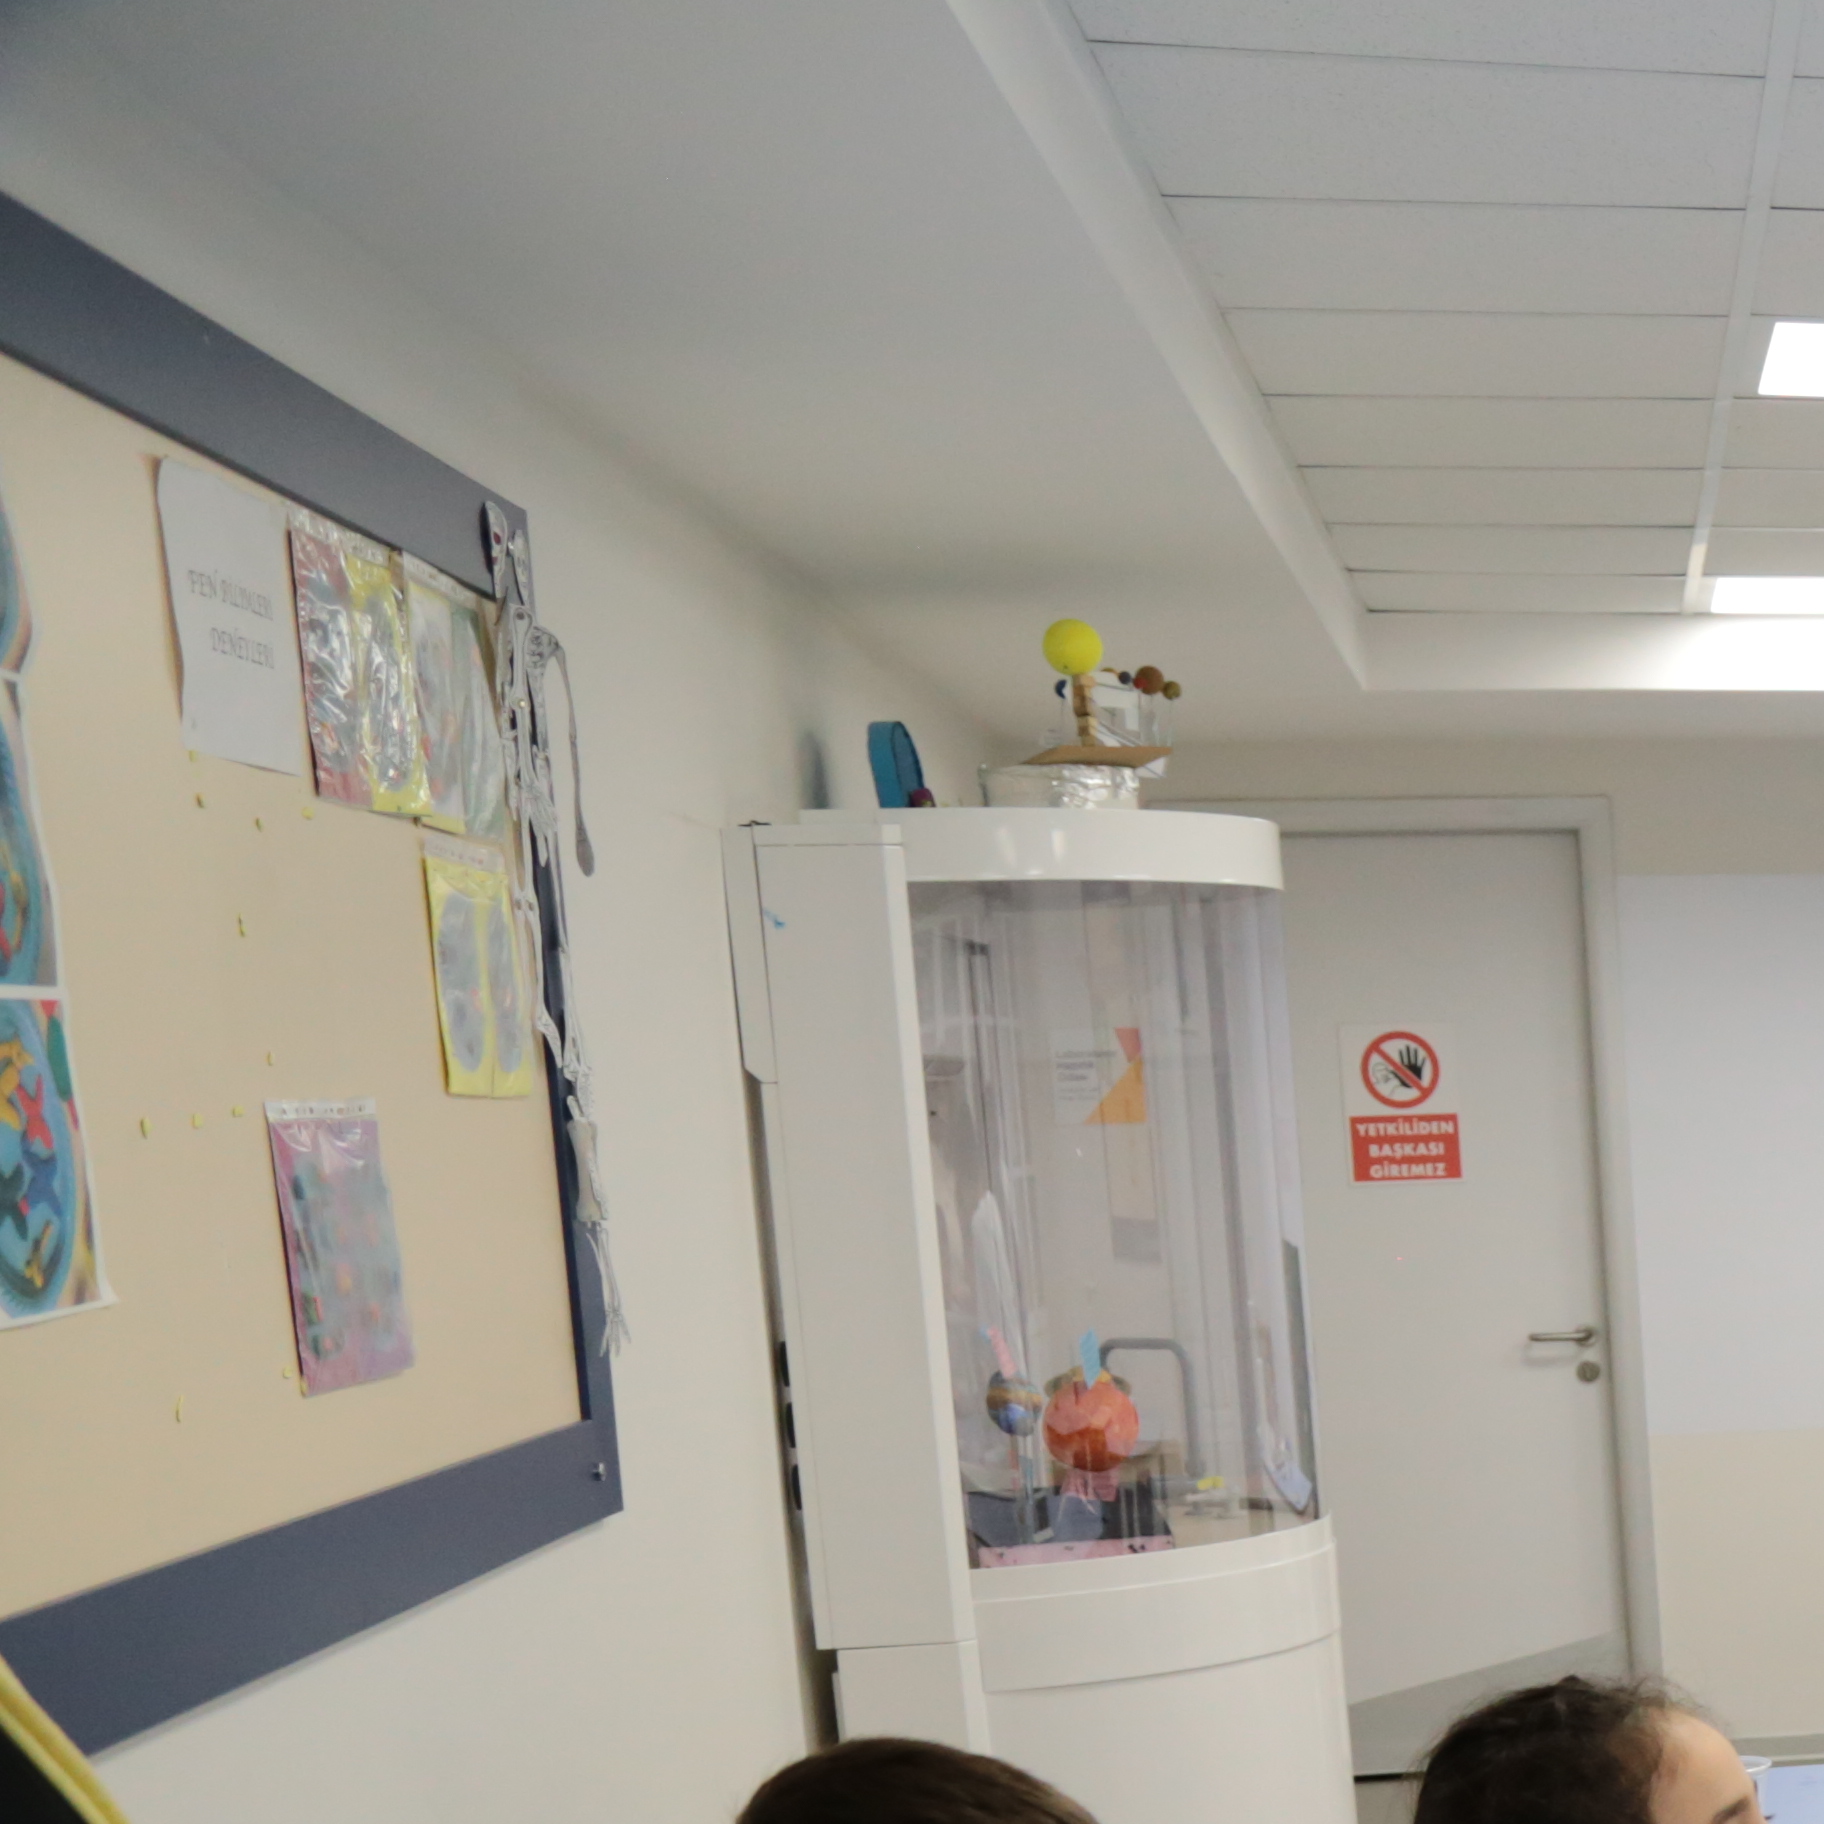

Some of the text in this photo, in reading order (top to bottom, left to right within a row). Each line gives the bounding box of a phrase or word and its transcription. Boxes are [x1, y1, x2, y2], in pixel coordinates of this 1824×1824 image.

[1356, 1117, 1454, 1137] YETKİLİDEN
[1368, 1142, 1444, 1159] BAŞKASI
[1369, 1162, 1447, 1179] GİREMEZ
